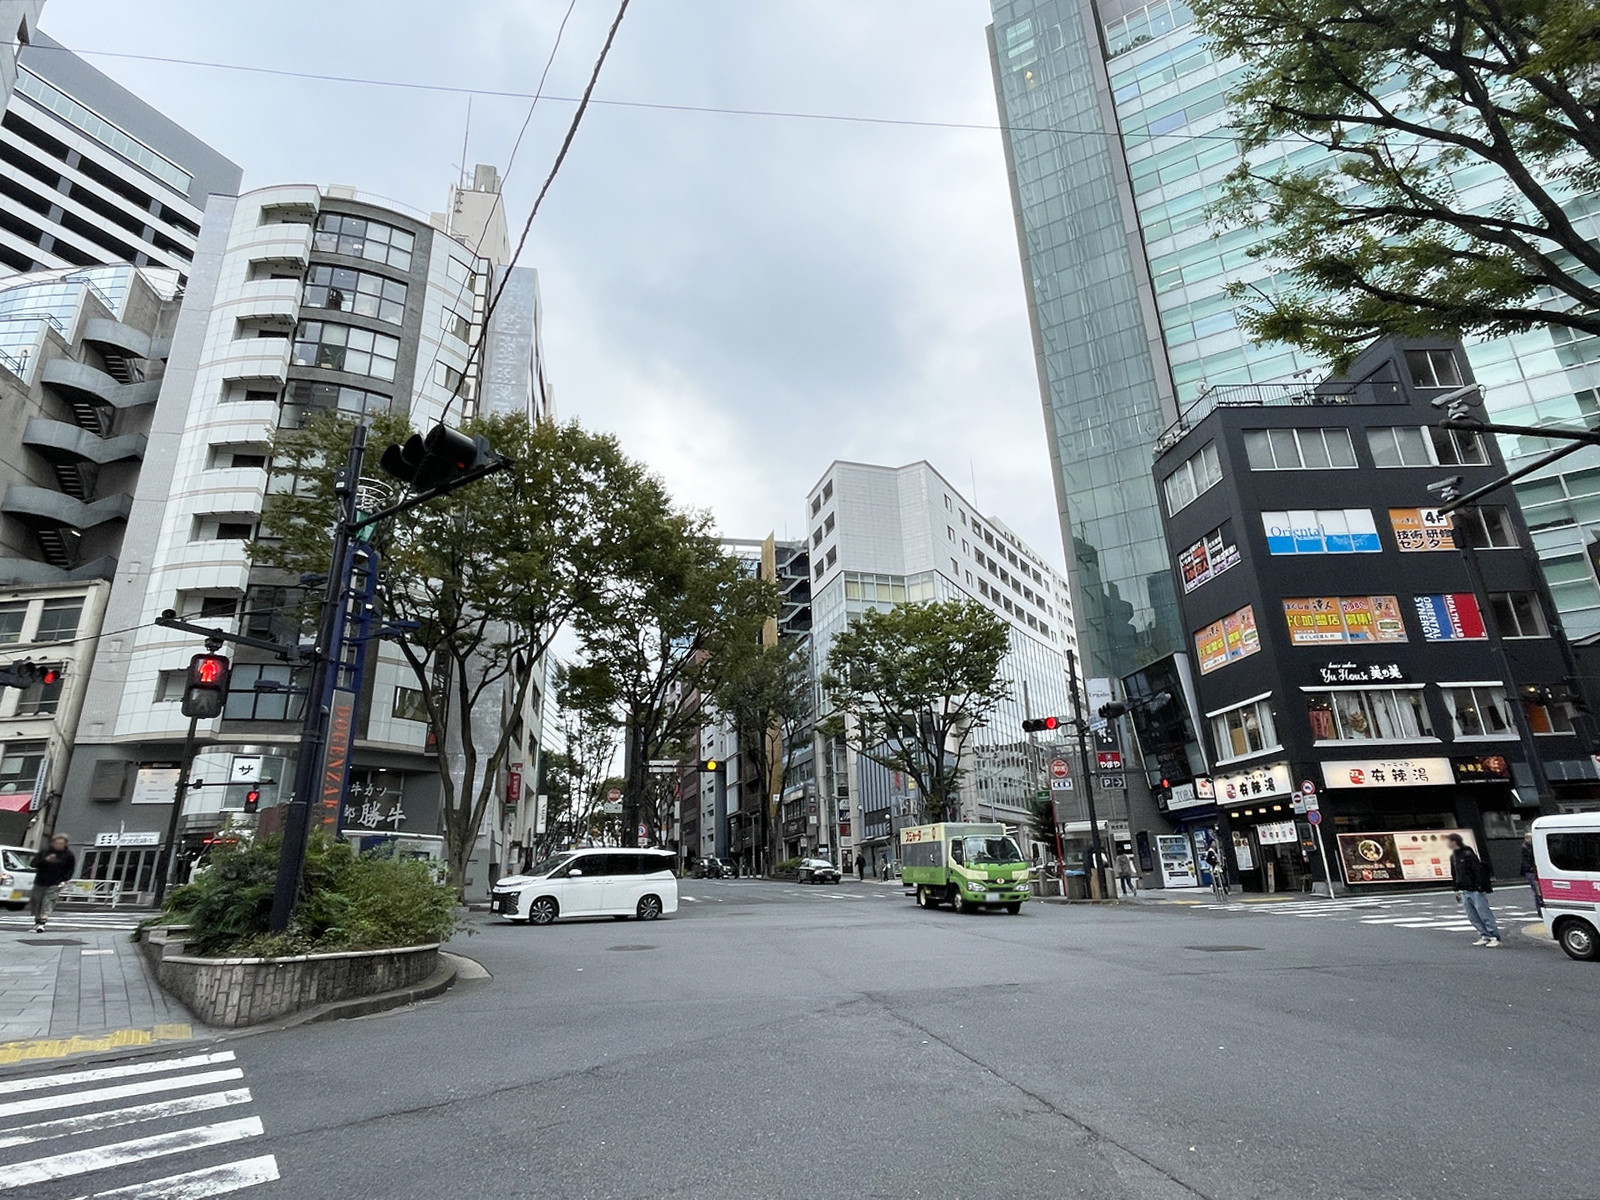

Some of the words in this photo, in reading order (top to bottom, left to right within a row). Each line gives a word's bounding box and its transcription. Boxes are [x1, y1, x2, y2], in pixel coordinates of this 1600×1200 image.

[1270, 524, 1326, 537] Oriental
[1396, 529, 1452, 540] 技術研修
[1400, 539, 1453, 549] センター
[1413, 597, 1434, 639] SYNERGY
[1423, 596, 1442, 639] ORIENTAL
[1445, 594, 1460, 623] HEALTH
[1453, 623, 1465, 638] LAB
[1338, 668, 1368, 681] House
[238, 764, 254, 776] サ
[1370, 767, 1429, 783] 麻辣湯
[350, 781, 387, 797] 牛カツ
[1103, 778, 1111, 787] P
